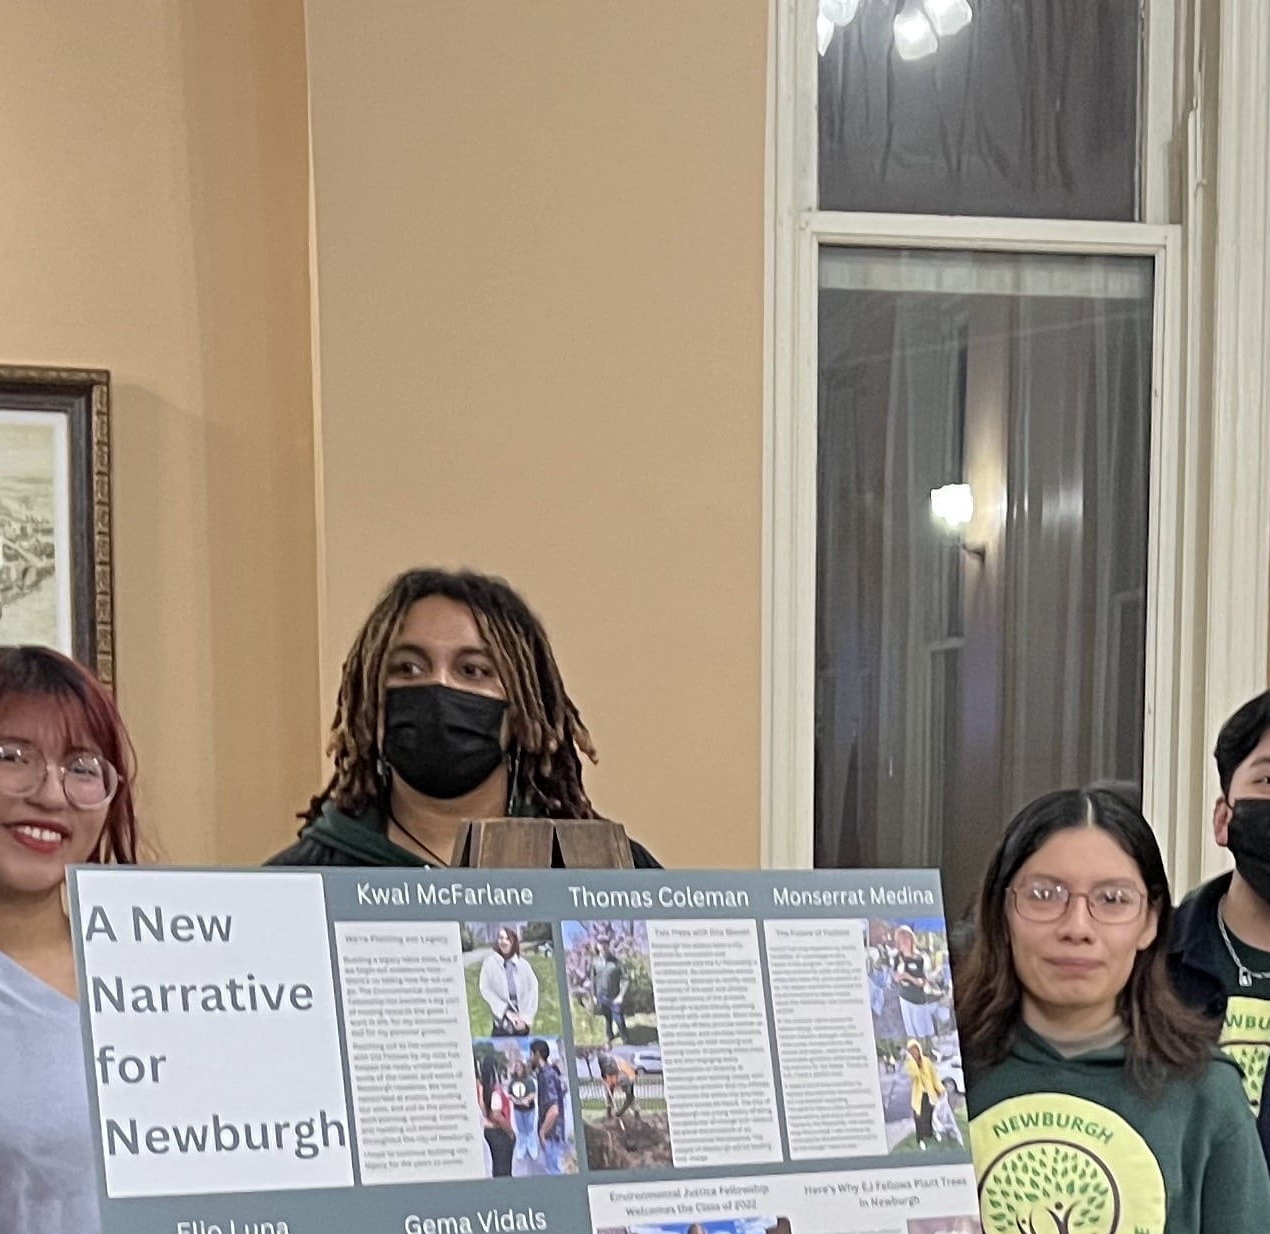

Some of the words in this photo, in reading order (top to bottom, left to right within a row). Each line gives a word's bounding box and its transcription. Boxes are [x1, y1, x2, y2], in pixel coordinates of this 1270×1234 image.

[417, 882, 533, 906] McFarlane
[568, 886, 653, 909] Thomas
[657, 885, 749, 908] Coleman
[772, 887, 865, 907] Monserrat
[870, 885, 935, 906] Medina
[85, 906, 117, 942] A
[133, 905, 233, 942] New
[92, 972, 315, 1014] Narrative
[96, 1045, 167, 1085] for
[105, 1109, 347, 1160] Newburgh
[992, 1112, 1114, 1145] NEWBURGH
[610, 1188, 681, 1203] Environmental
[683, 1186, 718, 1198] Justice
[804, 1183, 837, 1196] Here's
[838, 1183, 860, 1195] Why
[875, 1179, 912, 1192] Fellows
[940, 1176, 968, 1188] Trees
[626, 1203, 676, 1217] Welcomes
[677, 1203, 694, 1214] the
[696, 1201, 721, 1213] Class
[871, 1194, 921, 1208] Newburgh
[477, 1207, 548, 1233] Vidals
